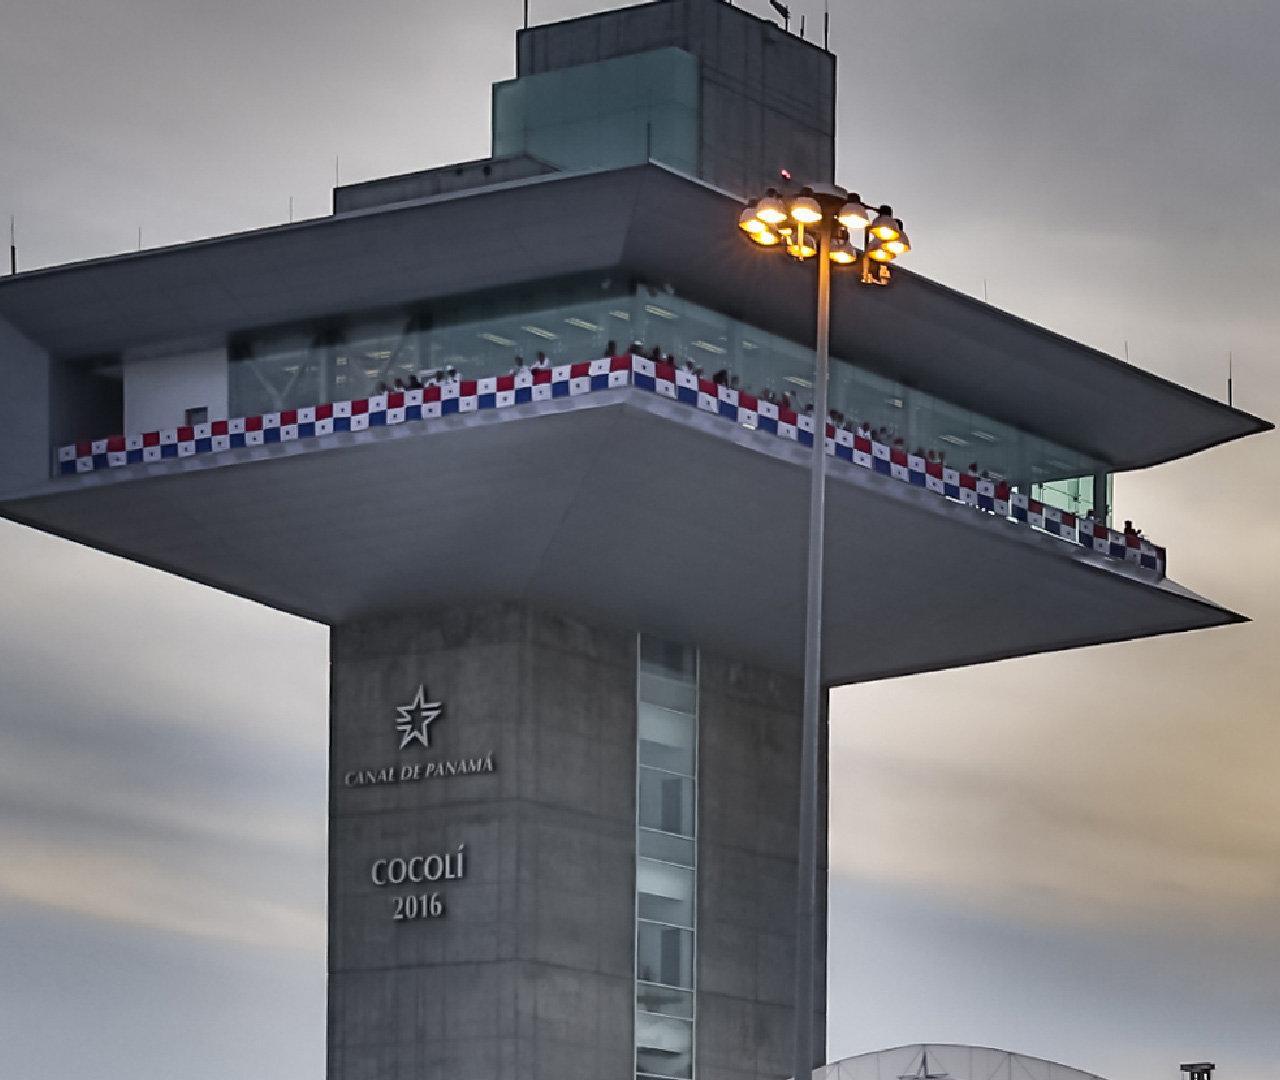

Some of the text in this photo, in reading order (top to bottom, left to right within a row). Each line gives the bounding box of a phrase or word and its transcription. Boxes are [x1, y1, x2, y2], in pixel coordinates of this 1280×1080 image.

[345, 751, 494, 785] CANAL DE PANAMÁ
[371, 841, 465, 885] COCOLÍ
[393, 892, 442, 920] 2016
